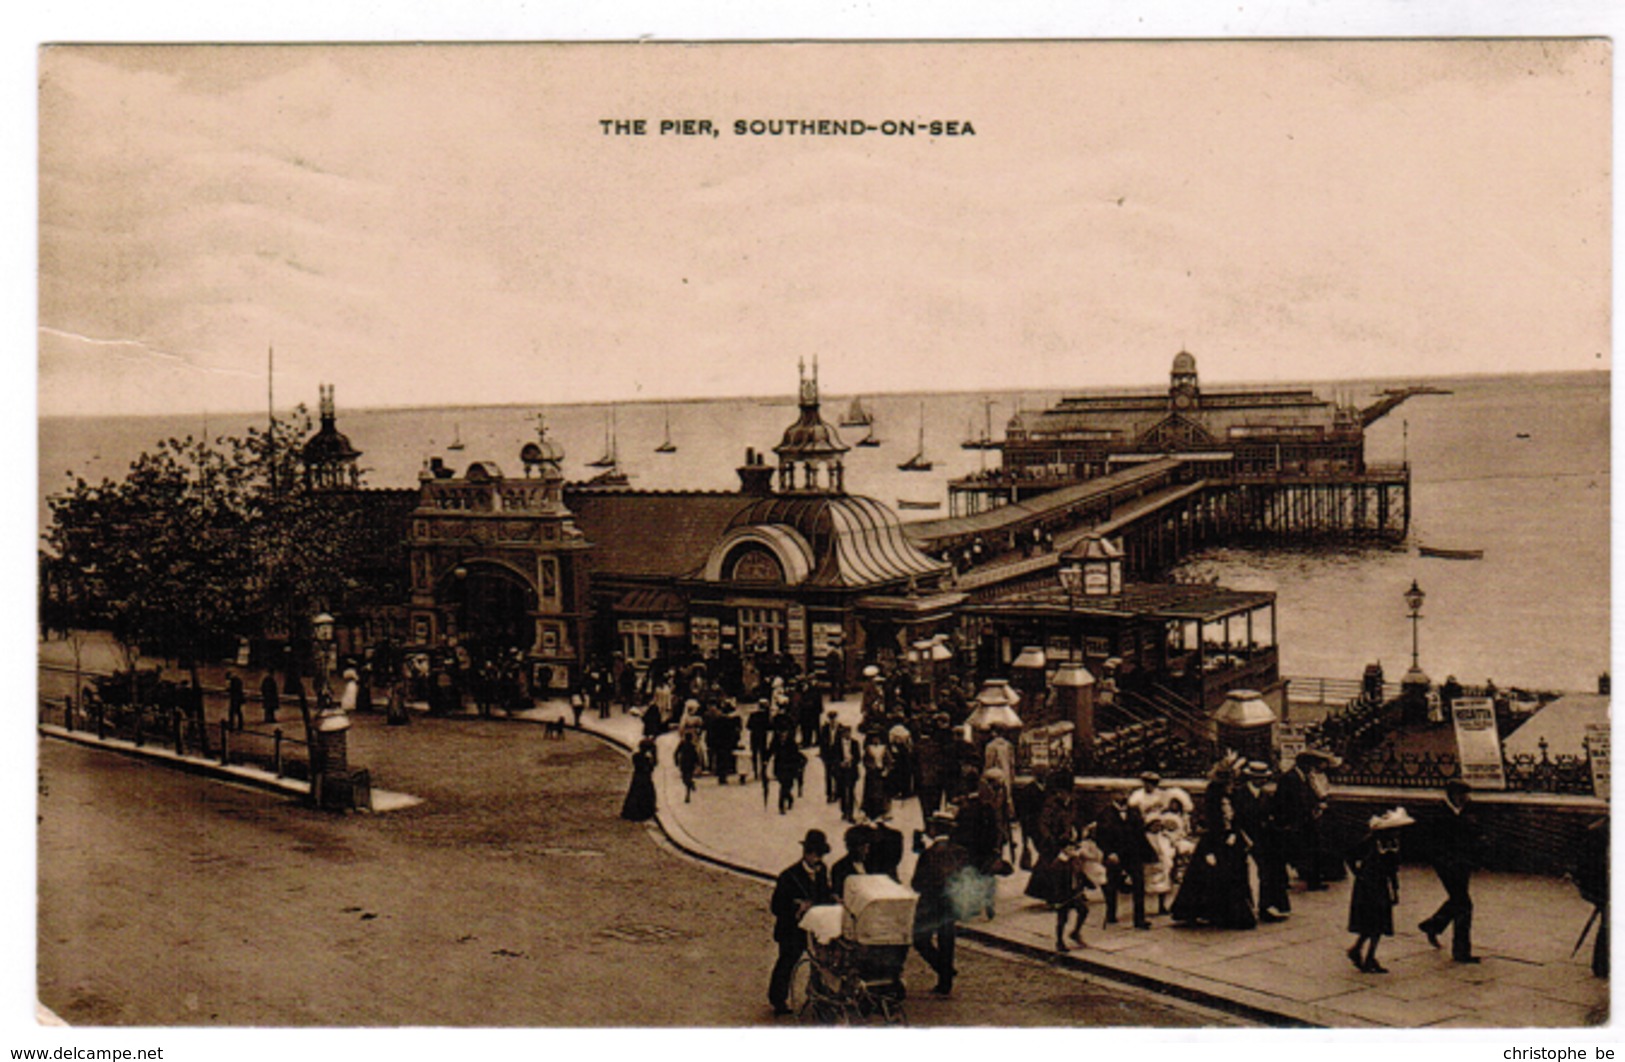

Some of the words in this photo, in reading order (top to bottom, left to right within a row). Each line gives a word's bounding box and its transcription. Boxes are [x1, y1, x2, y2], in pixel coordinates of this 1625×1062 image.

[600, 119, 647, 136] THE
[660, 119, 720, 138] PIER,
[733, 119, 976, 136] SOUTHEND-ON-SEA
